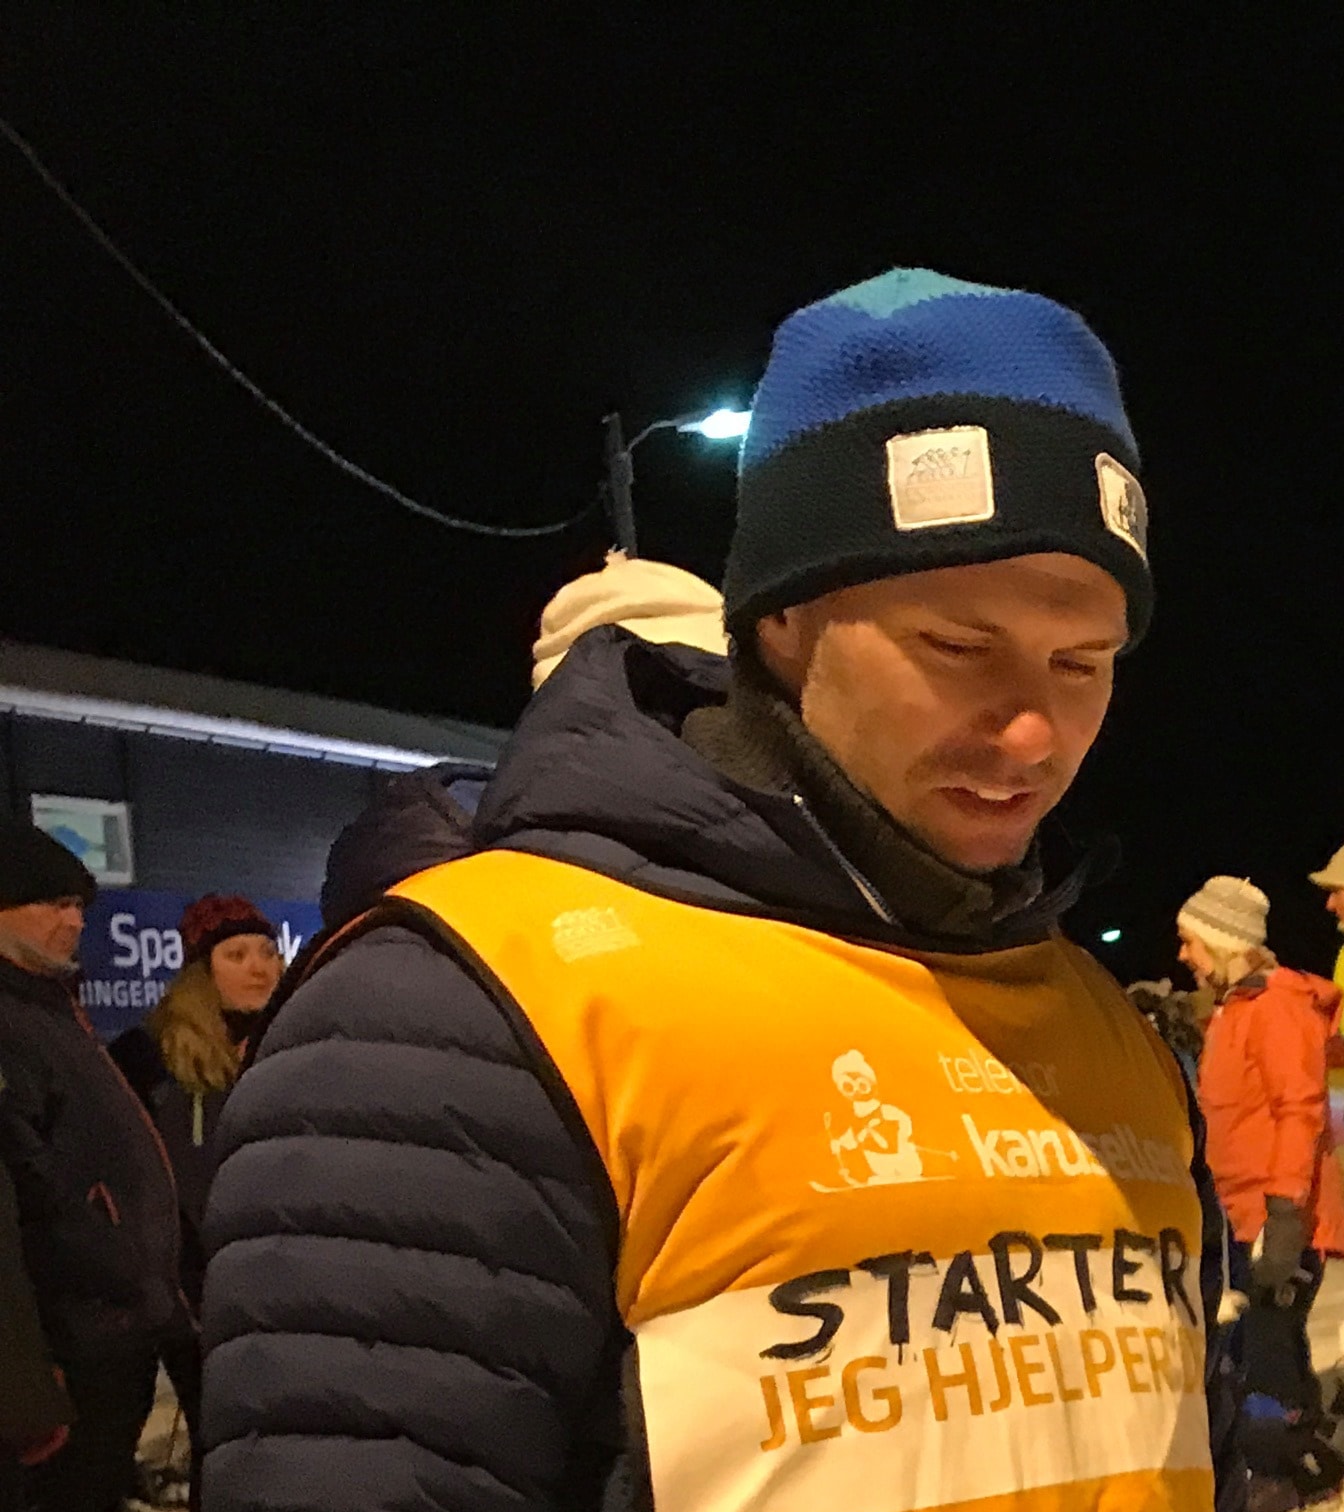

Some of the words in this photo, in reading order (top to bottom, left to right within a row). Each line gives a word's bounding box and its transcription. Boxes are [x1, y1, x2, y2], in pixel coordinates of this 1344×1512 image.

[759, 1227, 1198, 1364] STARTER
[760, 1355, 902, 1452] JEG
[923, 1326, 1179, 1422] HJELPER
